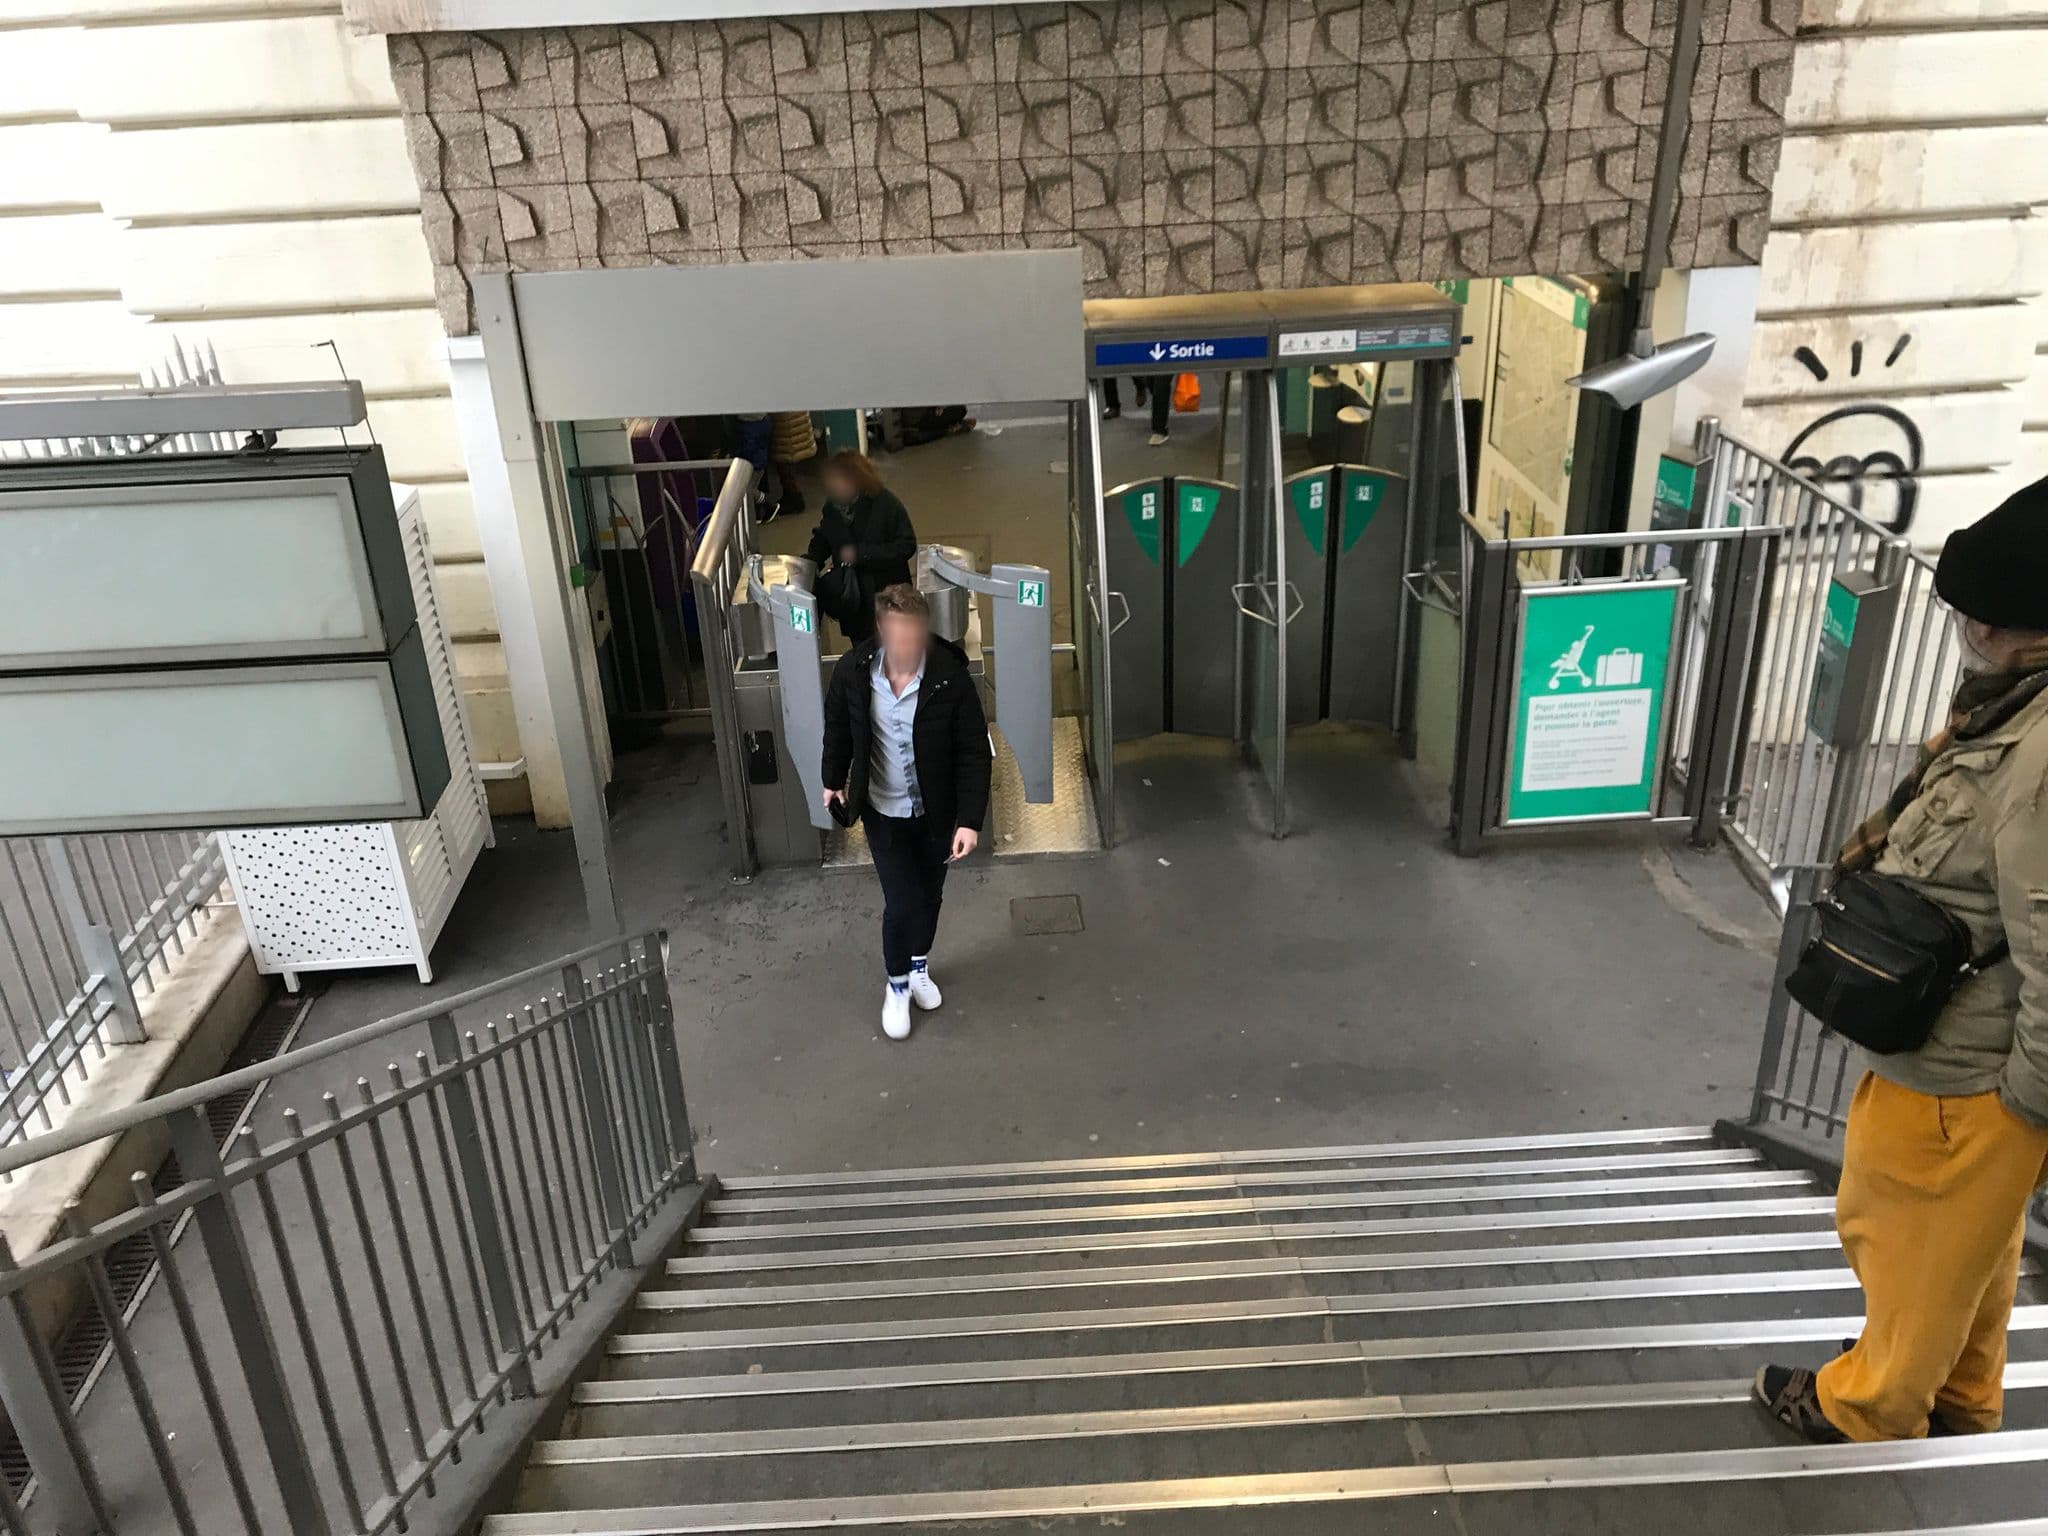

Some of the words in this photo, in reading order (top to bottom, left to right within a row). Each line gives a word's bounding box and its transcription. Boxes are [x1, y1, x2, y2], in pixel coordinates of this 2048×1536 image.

[1169, 341, 1215, 358] Sortie
[1535, 703, 1556, 712] Pour
[1558, 700, 1591, 709] obtenir
[1534, 711, 1578, 721] demander
[1589, 708, 1620, 719] l'agent
[1533, 723, 1542, 731] et
[1544, 721, 1579, 732] pousser
[1582, 719, 1590, 729] la
[1592, 718, 1618, 729] porte
